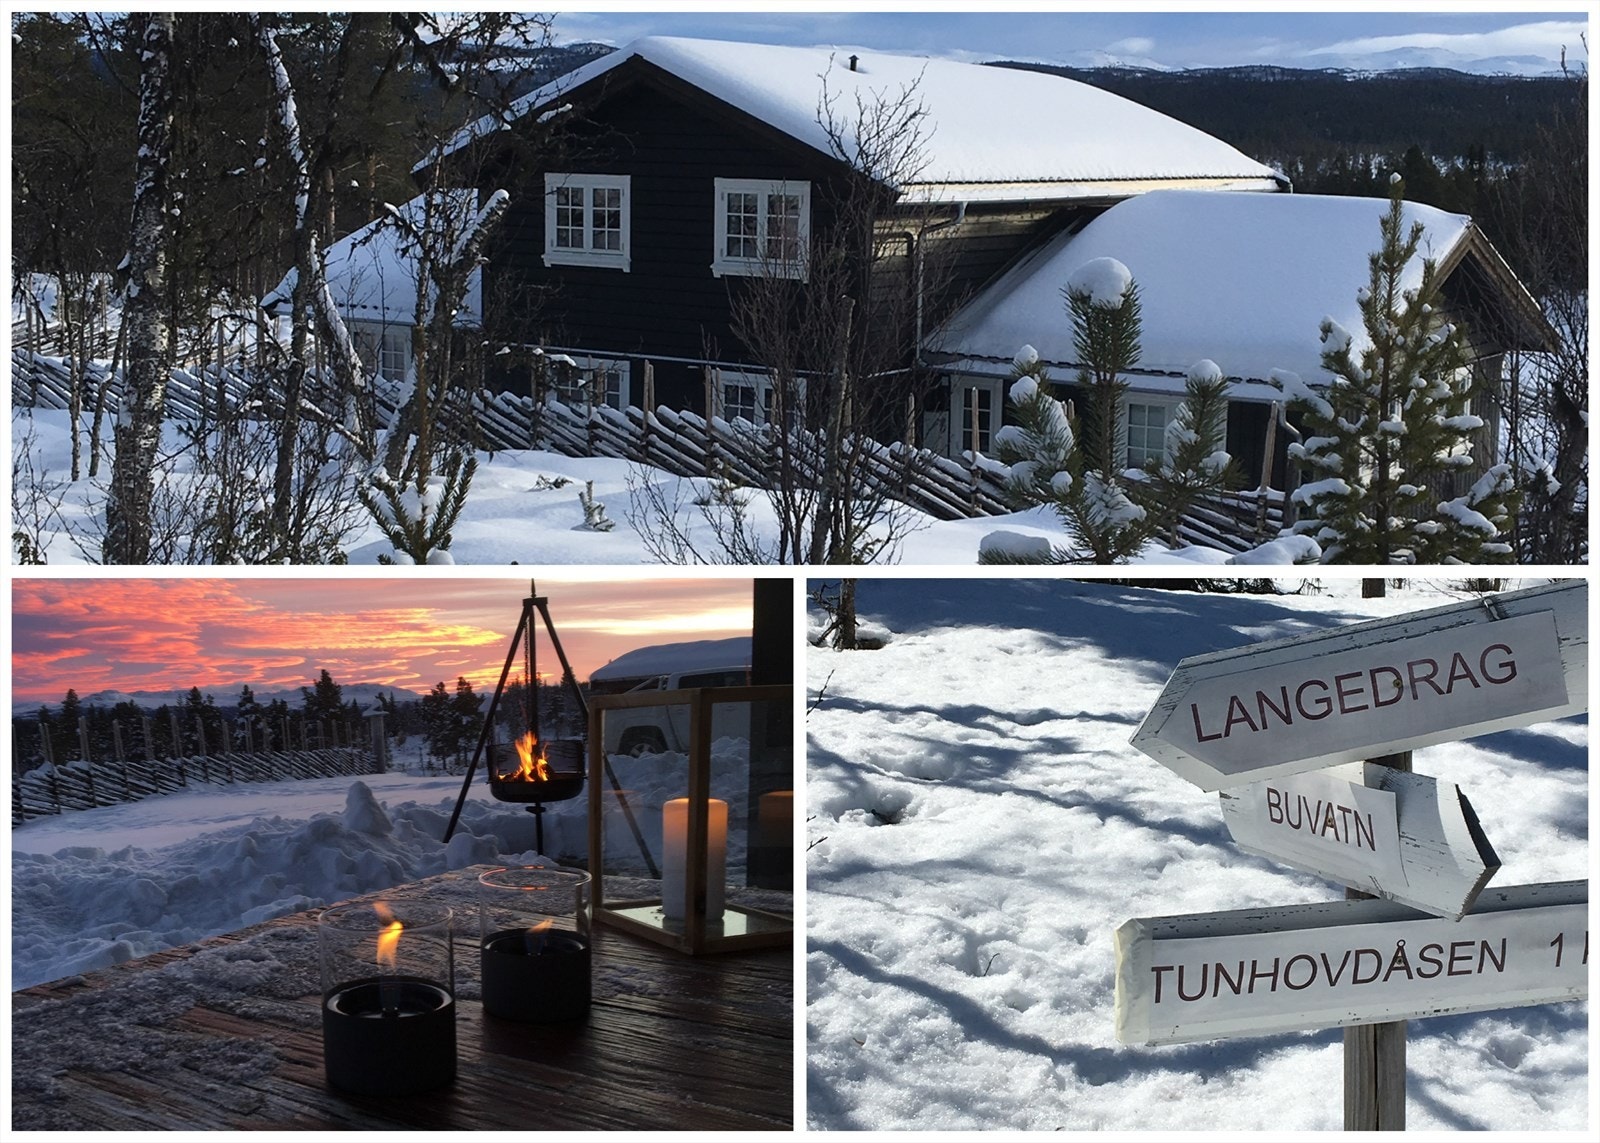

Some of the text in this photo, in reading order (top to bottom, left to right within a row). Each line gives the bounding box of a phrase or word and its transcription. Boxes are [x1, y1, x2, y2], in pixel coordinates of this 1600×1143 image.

[1190, 643, 1518, 743] LANGEDRAG
[1266, 787, 1376, 852] BUVATN
[1151, 938, 1507, 1004] TUNHOVDÅSEN
[1550, 932, 1563, 968] 1
